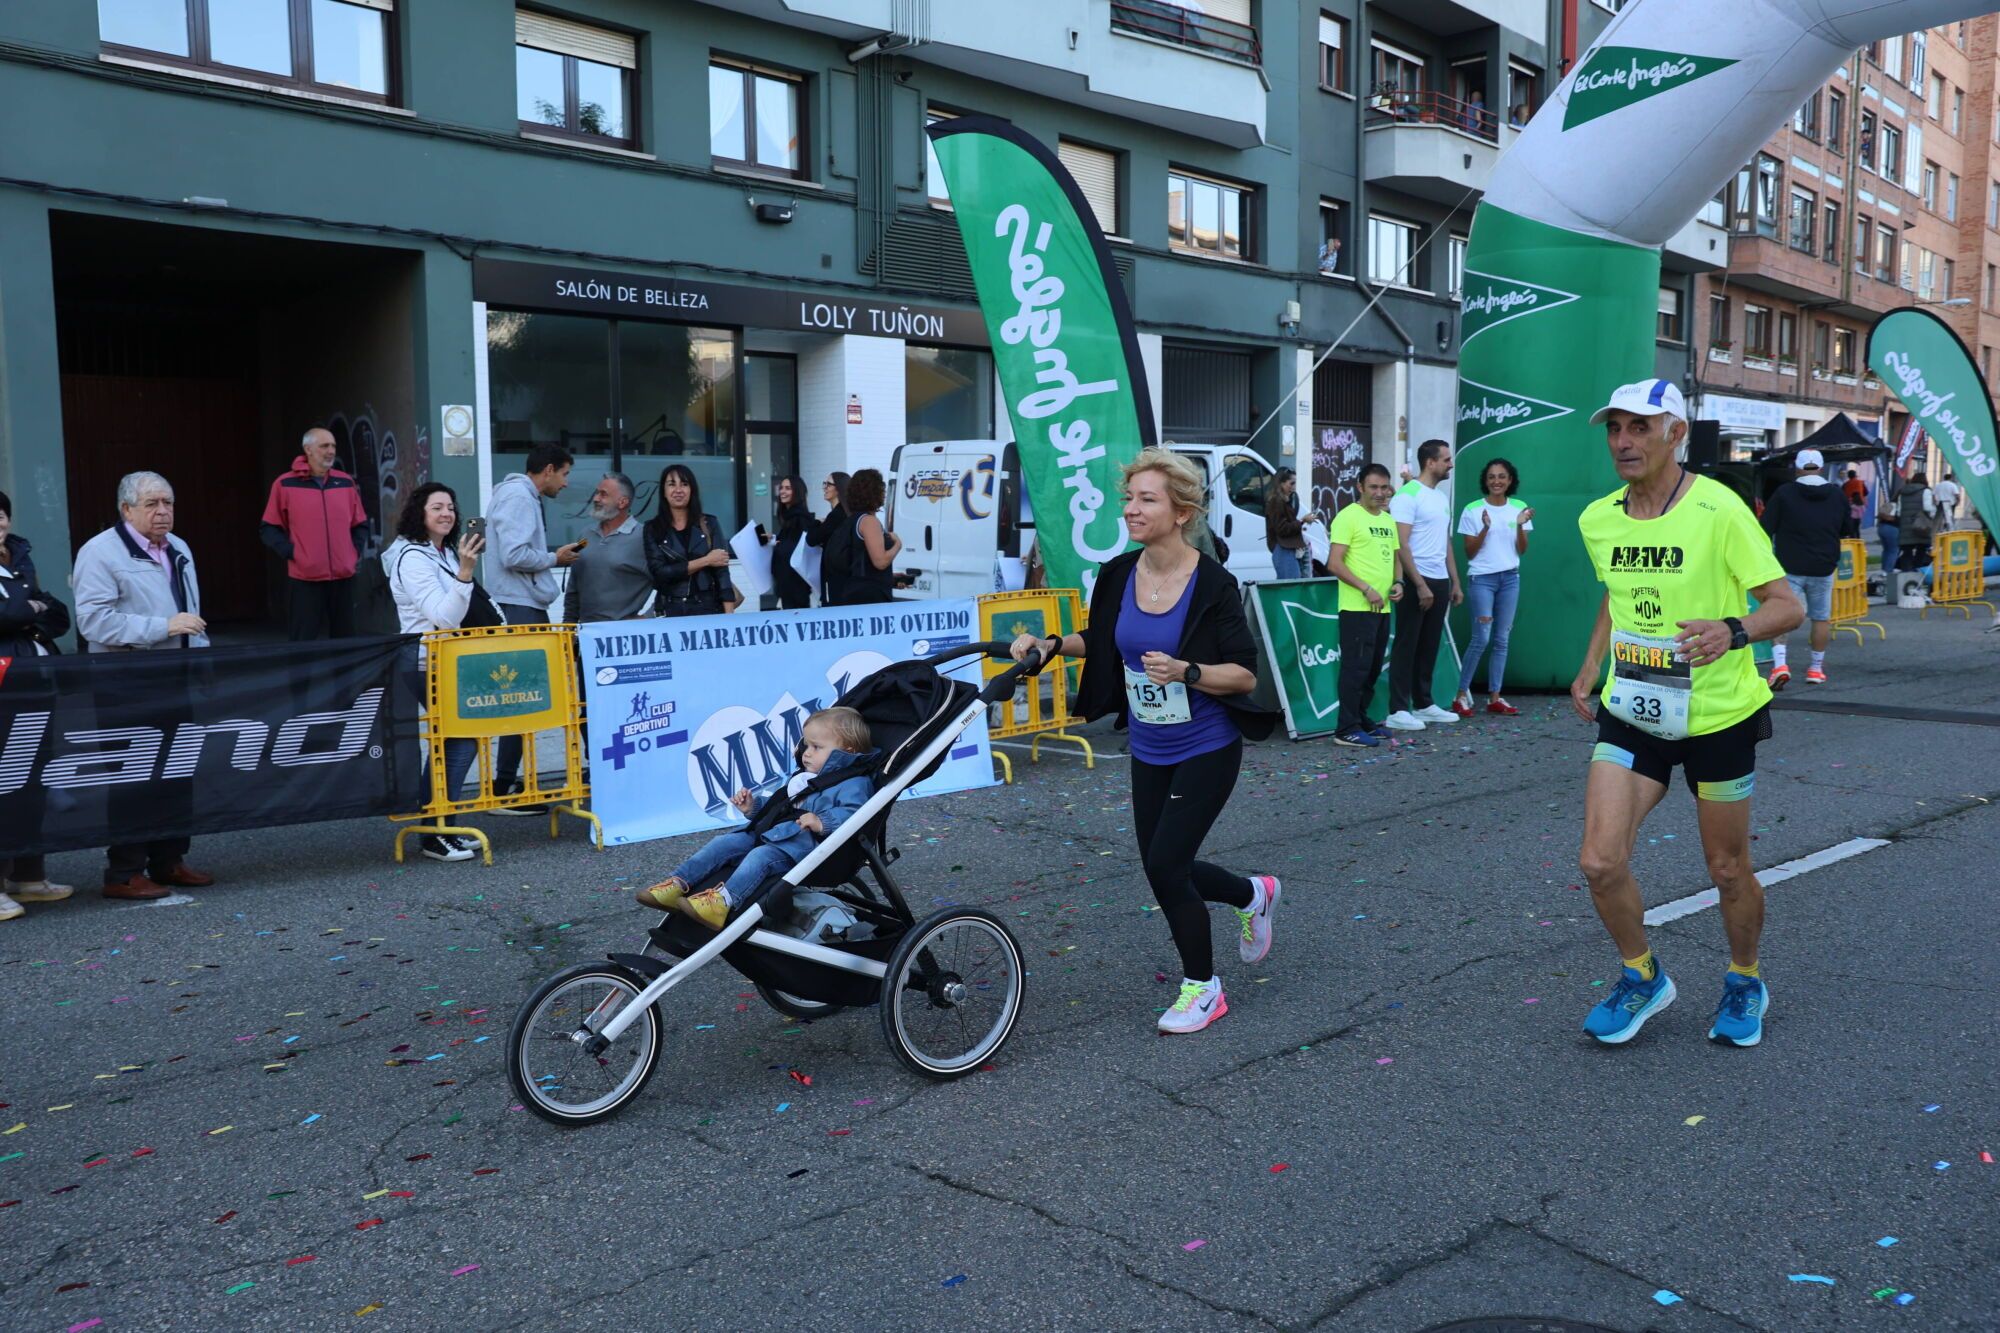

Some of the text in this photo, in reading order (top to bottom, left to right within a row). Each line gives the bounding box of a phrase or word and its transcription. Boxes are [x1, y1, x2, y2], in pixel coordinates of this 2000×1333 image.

[1574, 57, 1697, 93] El Corte Inglés
[556, 279, 709, 309] SALÓN DE BELLEZA
[1464, 294, 1485, 312] Corte
[1485, 286, 1538, 314] Inglés
[801, 302, 944, 337] LOLY TUÑON
[1459, 404, 1480, 420] Corte
[1480, 397, 1531, 424] Inglés
[1635, 600, 1662, 619] MOM
[594, 610, 970, 658] MEDIA MARATÓN VERDE DE OVIEDO
[1615, 641, 1673, 669] CIERRE
[466, 690, 543, 707] CAJA RURAL
[1133, 684, 1168, 702] 151
[1632, 695, 1662, 718] 33
[652, 702, 673, 716] CLUB
[624, 716, 669, 736] DEPORTIVO
